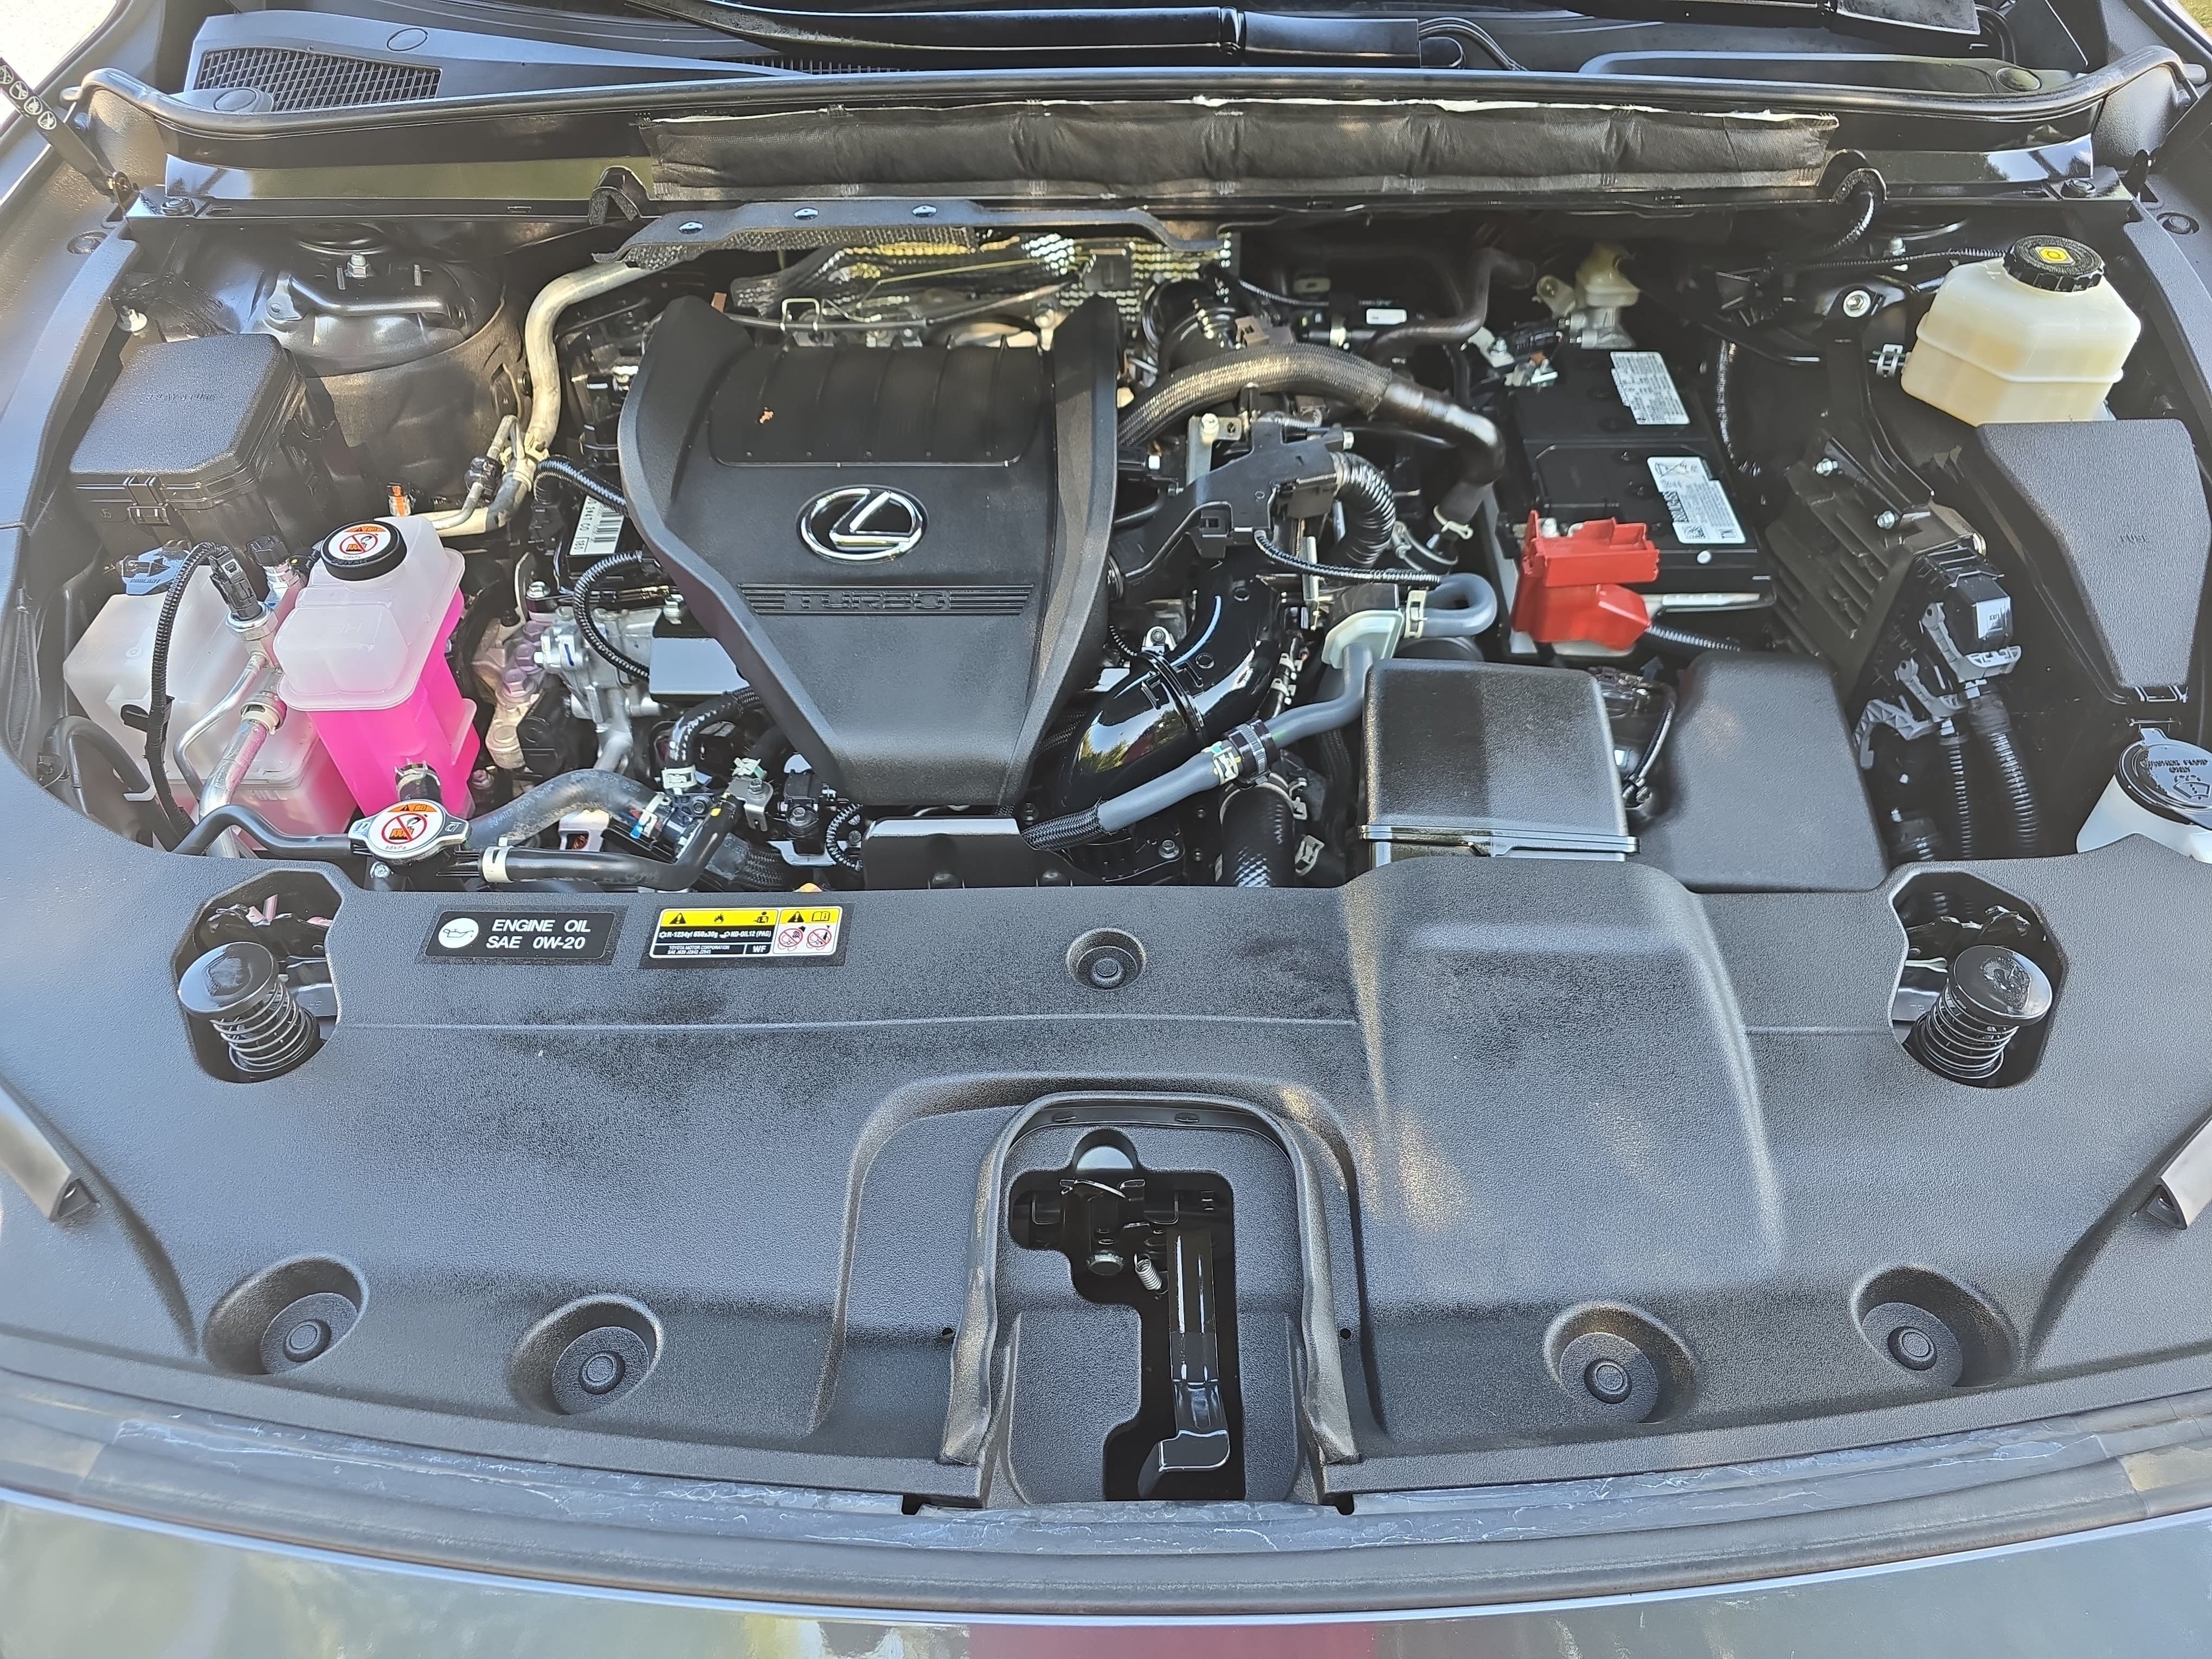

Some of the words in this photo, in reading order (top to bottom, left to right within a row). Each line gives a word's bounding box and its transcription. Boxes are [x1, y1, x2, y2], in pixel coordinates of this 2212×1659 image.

[190, 393, 217, 401] FUSE
[2120, 534, 2149, 542] FUSE
[789, 589, 948, 610] TURBO
[491, 919, 555, 932] ENGINE
[564, 919, 591, 933] OIL
[486, 935, 523, 949] SAE
[532, 936, 586, 949] 0W-20
